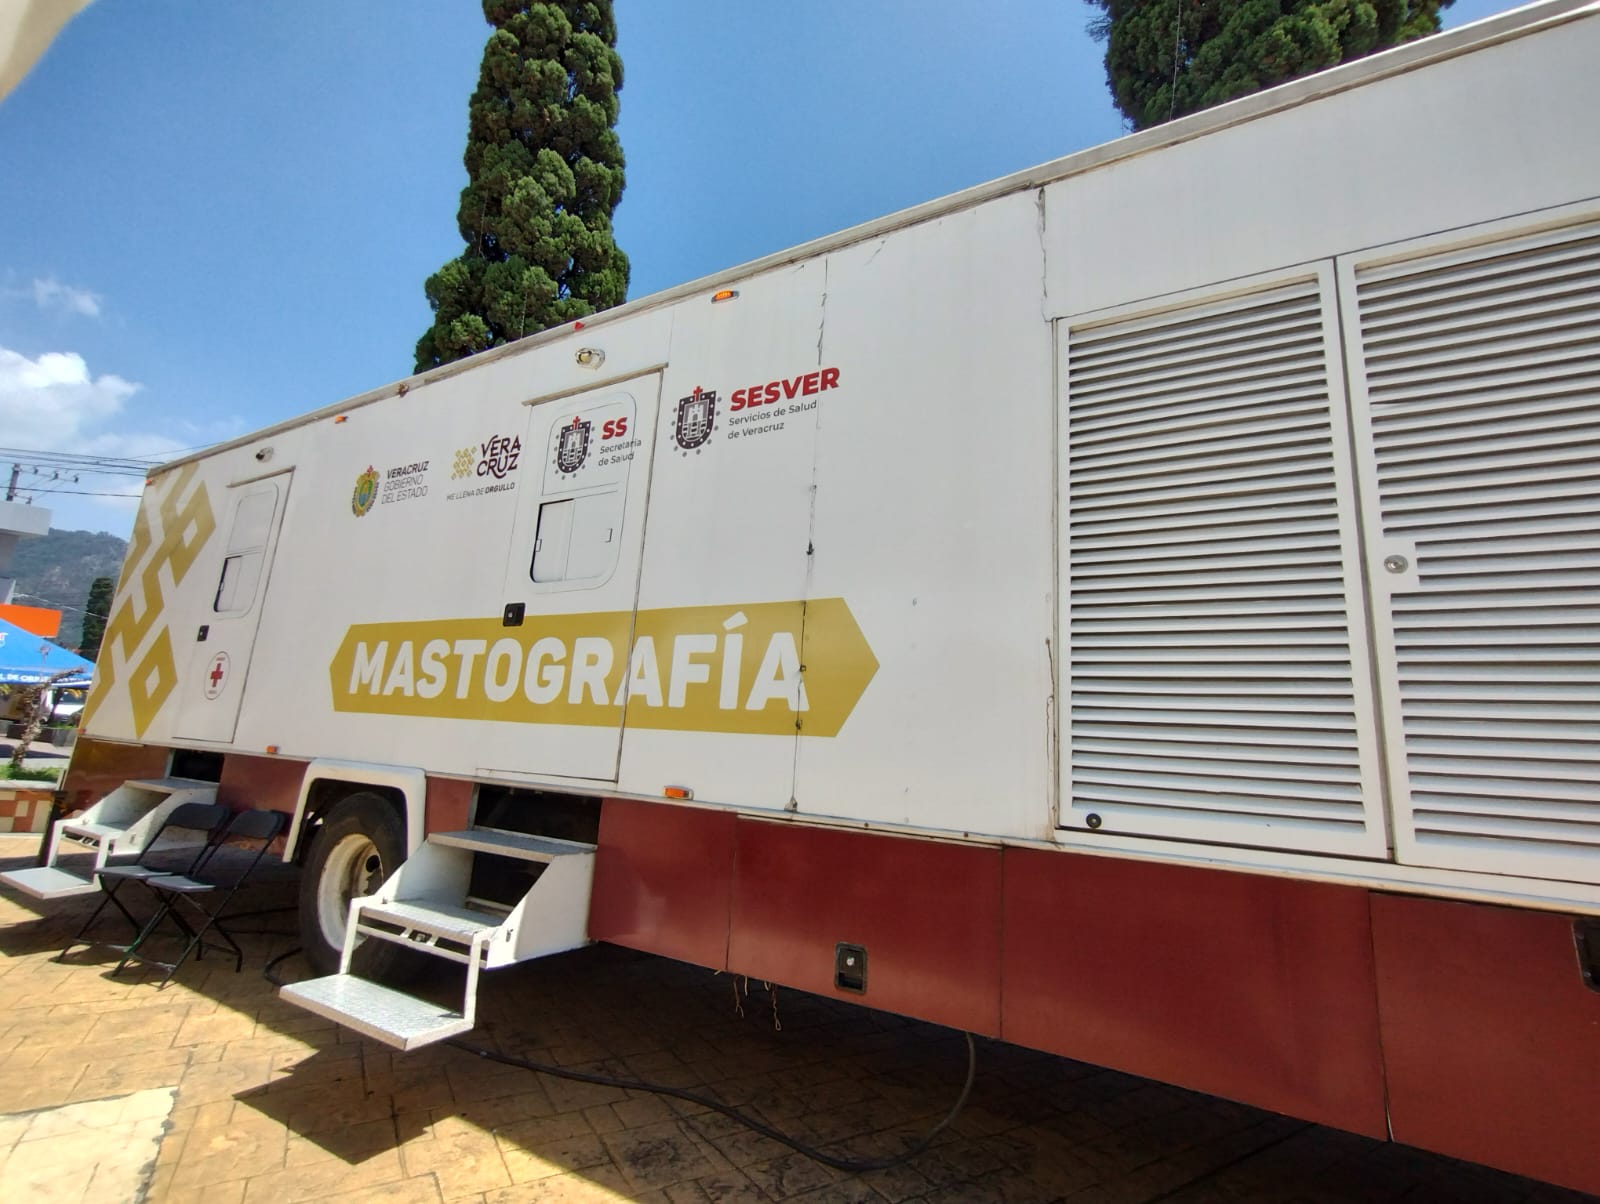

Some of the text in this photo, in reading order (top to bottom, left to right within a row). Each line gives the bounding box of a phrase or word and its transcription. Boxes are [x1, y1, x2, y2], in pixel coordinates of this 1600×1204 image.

[730, 367, 840, 411] SESVER
[728, 400, 817, 426] Servicios de Salud
[601, 416, 628, 440] SS
[727, 422, 785, 439] de Veracruz
[481, 435, 521, 458] VERA
[476, 453, 520, 479] CRUZ
[598, 451, 634, 466] de Salud
[387, 460, 430, 479] VERACRUZ
[384, 473, 424, 492] GOBIERNO
[455, 489, 475, 500] LLENA
[475, 487, 484, 496] DE
[484, 481, 516, 494] ORGULLO
[381, 485, 428, 505] DEL ESTADO
[348, 610, 811, 712] MASTOGRAFÍA
